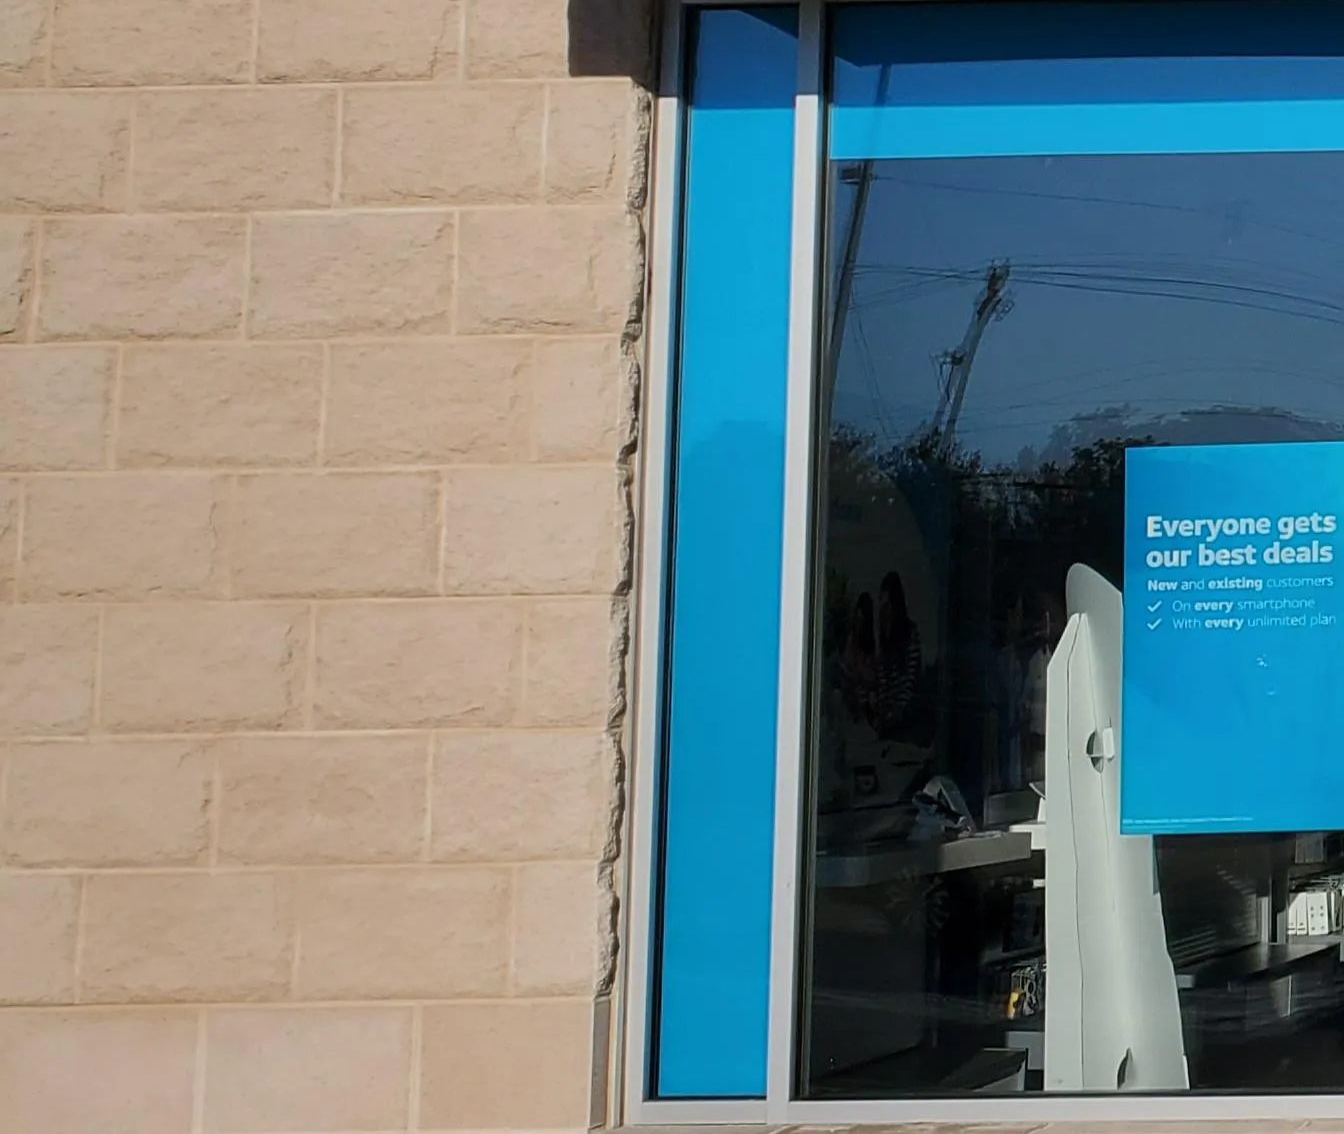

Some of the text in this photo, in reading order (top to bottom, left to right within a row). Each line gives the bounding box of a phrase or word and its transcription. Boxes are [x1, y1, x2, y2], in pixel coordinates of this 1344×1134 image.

[1145, 513, 1336, 542] Everyone gets
[1147, 540, 1333, 567] our best deals
[1148, 577, 1334, 591] New and existing customers
[1172, 598, 1315, 613] On every smartphone
[1173, 612, 1336, 630] With every unlimited plan
